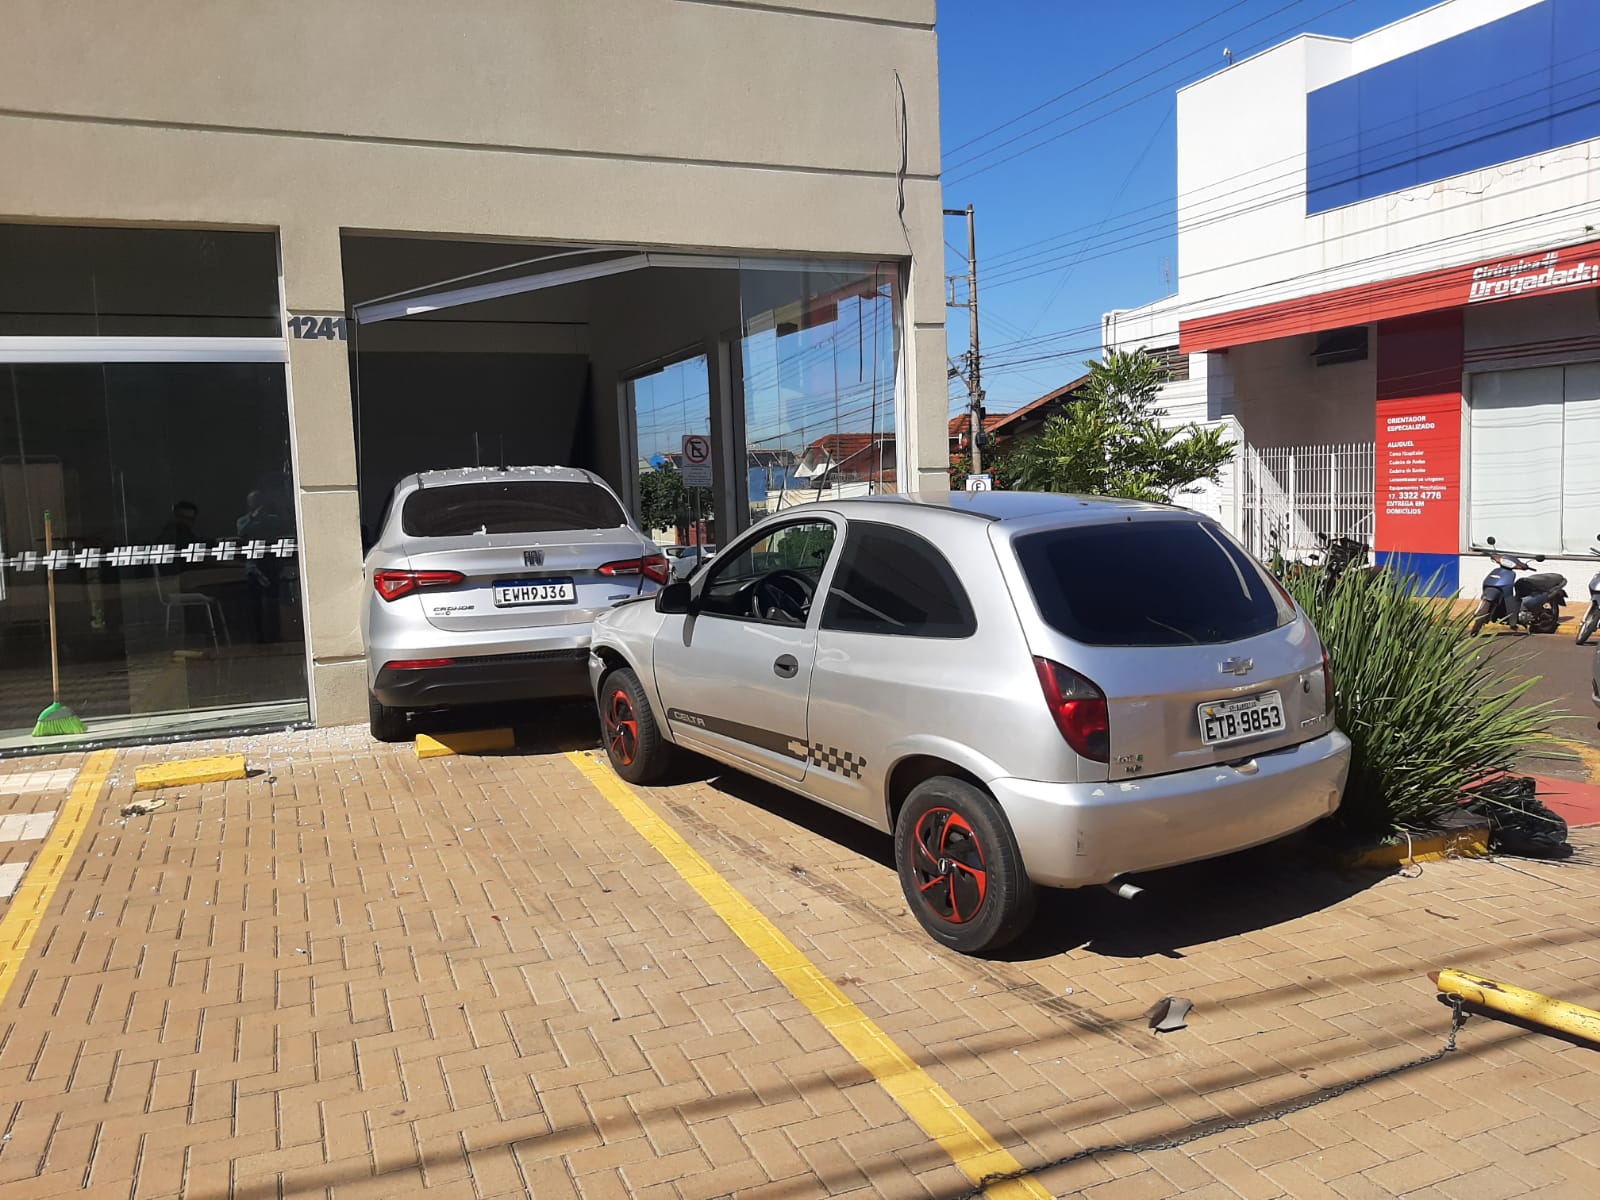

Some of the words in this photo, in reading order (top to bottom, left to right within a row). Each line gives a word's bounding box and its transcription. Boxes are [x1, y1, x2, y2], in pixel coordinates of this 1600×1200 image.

[288, 316, 347, 340] 1241
[1387, 415, 1426, 424] ORIENTADOR
[1399, 491, 1419, 499] 3322
[503, 585, 566, 602] EWH9J36
[673, 711, 706, 728] CELTA
